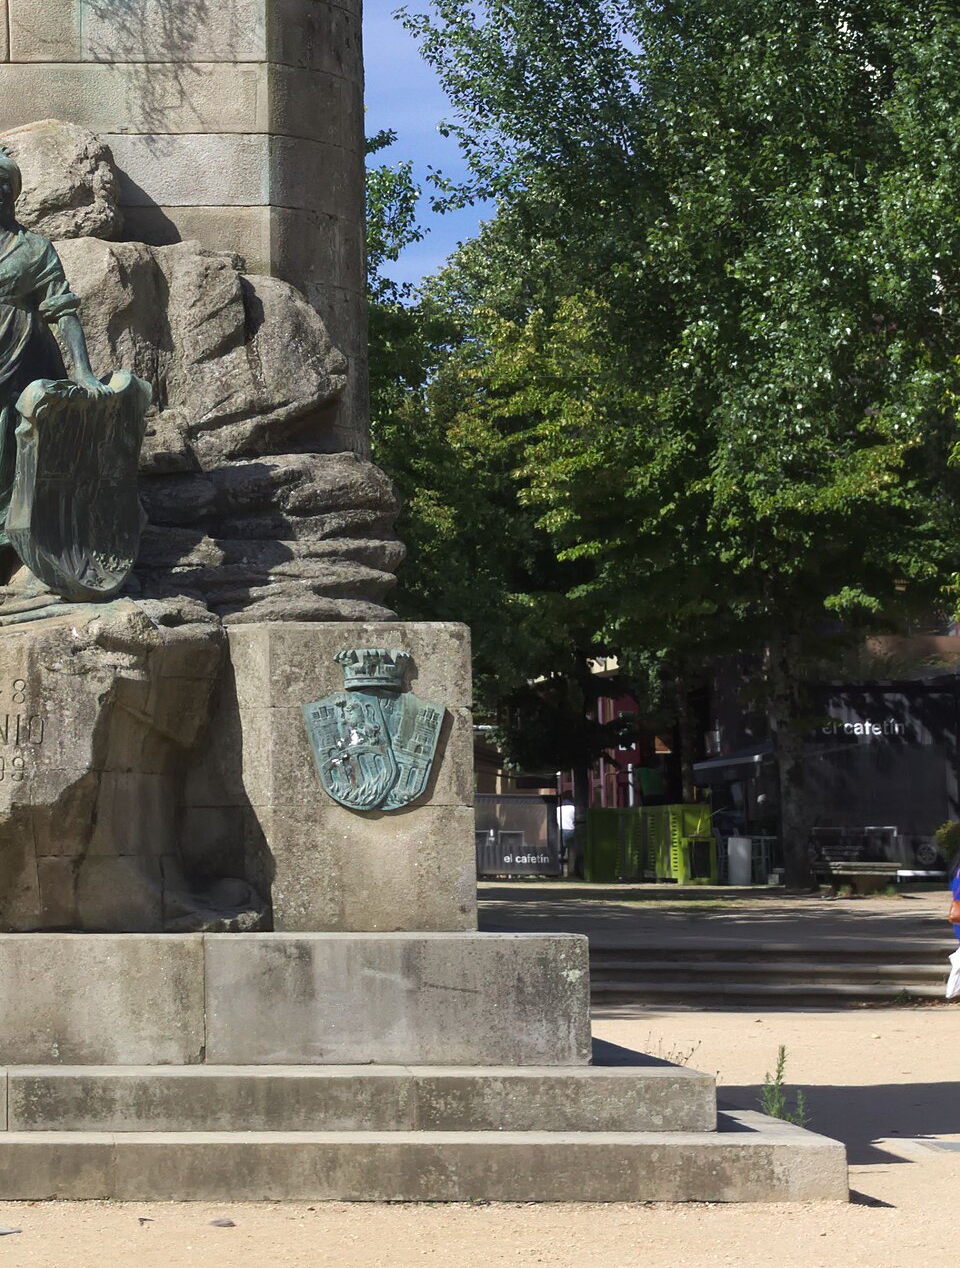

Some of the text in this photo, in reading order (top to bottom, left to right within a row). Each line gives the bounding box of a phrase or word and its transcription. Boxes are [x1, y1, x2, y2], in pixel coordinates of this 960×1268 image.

[12, 678, 27, 705] 8
[843, 718, 905, 735] cafetín
[503, 853, 550, 864] el cafetín
